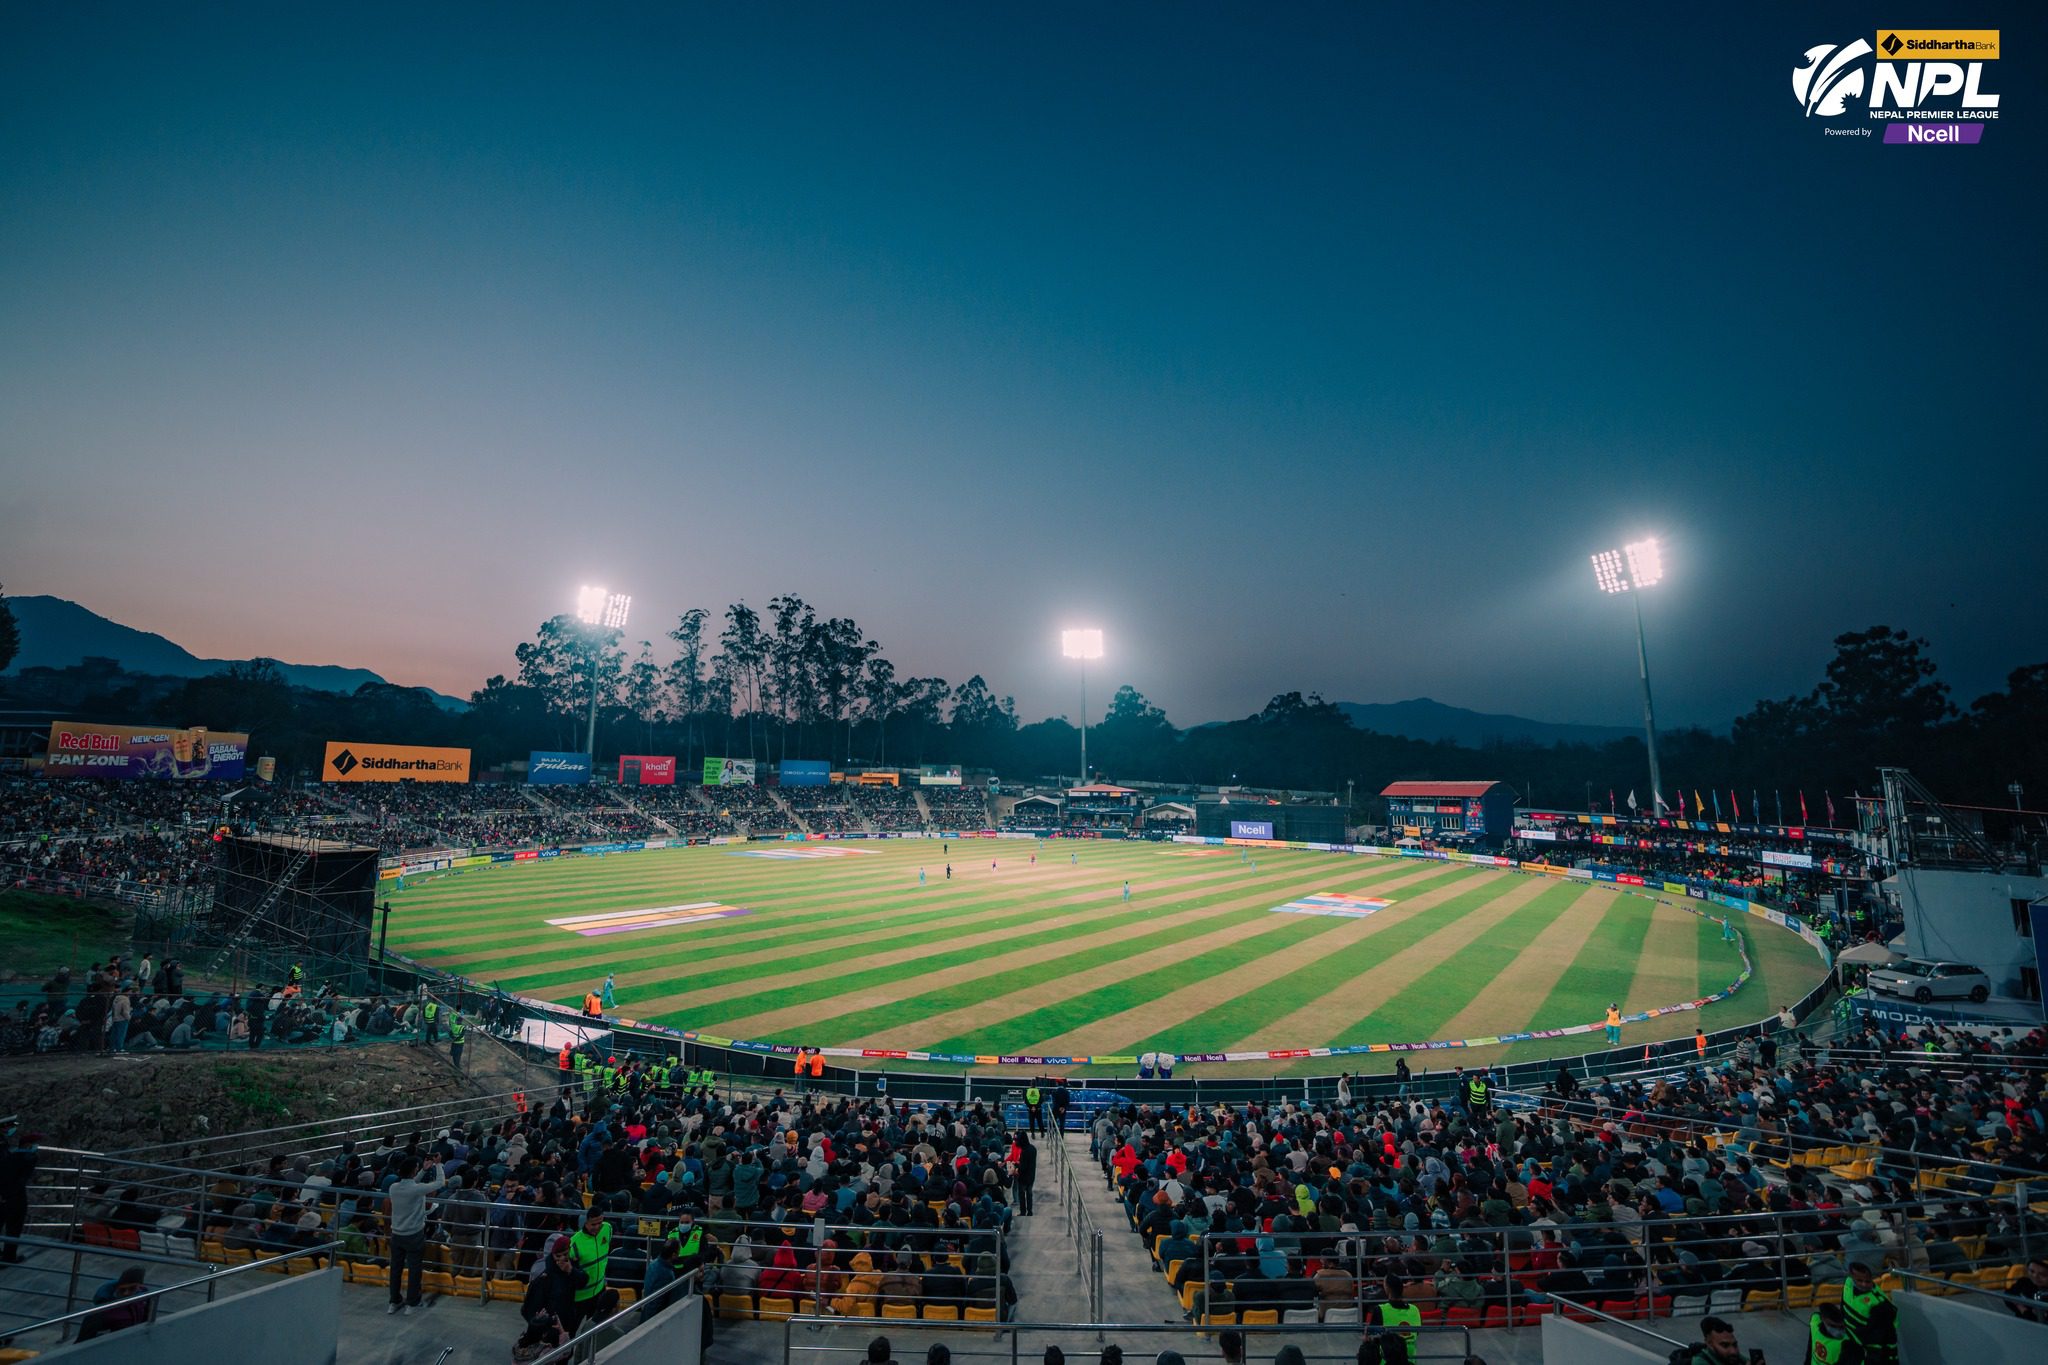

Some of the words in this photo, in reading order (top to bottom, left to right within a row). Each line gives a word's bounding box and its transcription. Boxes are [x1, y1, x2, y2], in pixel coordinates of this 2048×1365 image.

[58, 731, 89, 750] Red
[91, 734, 121, 751] Bull
[209, 744, 238, 755] BABAAL
[49, 753, 85, 766] FAN
[86, 754, 129, 766] ZONE
[645, 763, 669, 771] khalti
[1238, 824, 1265, 835] Ncell
[1689, 887, 1704, 899] Ncell
